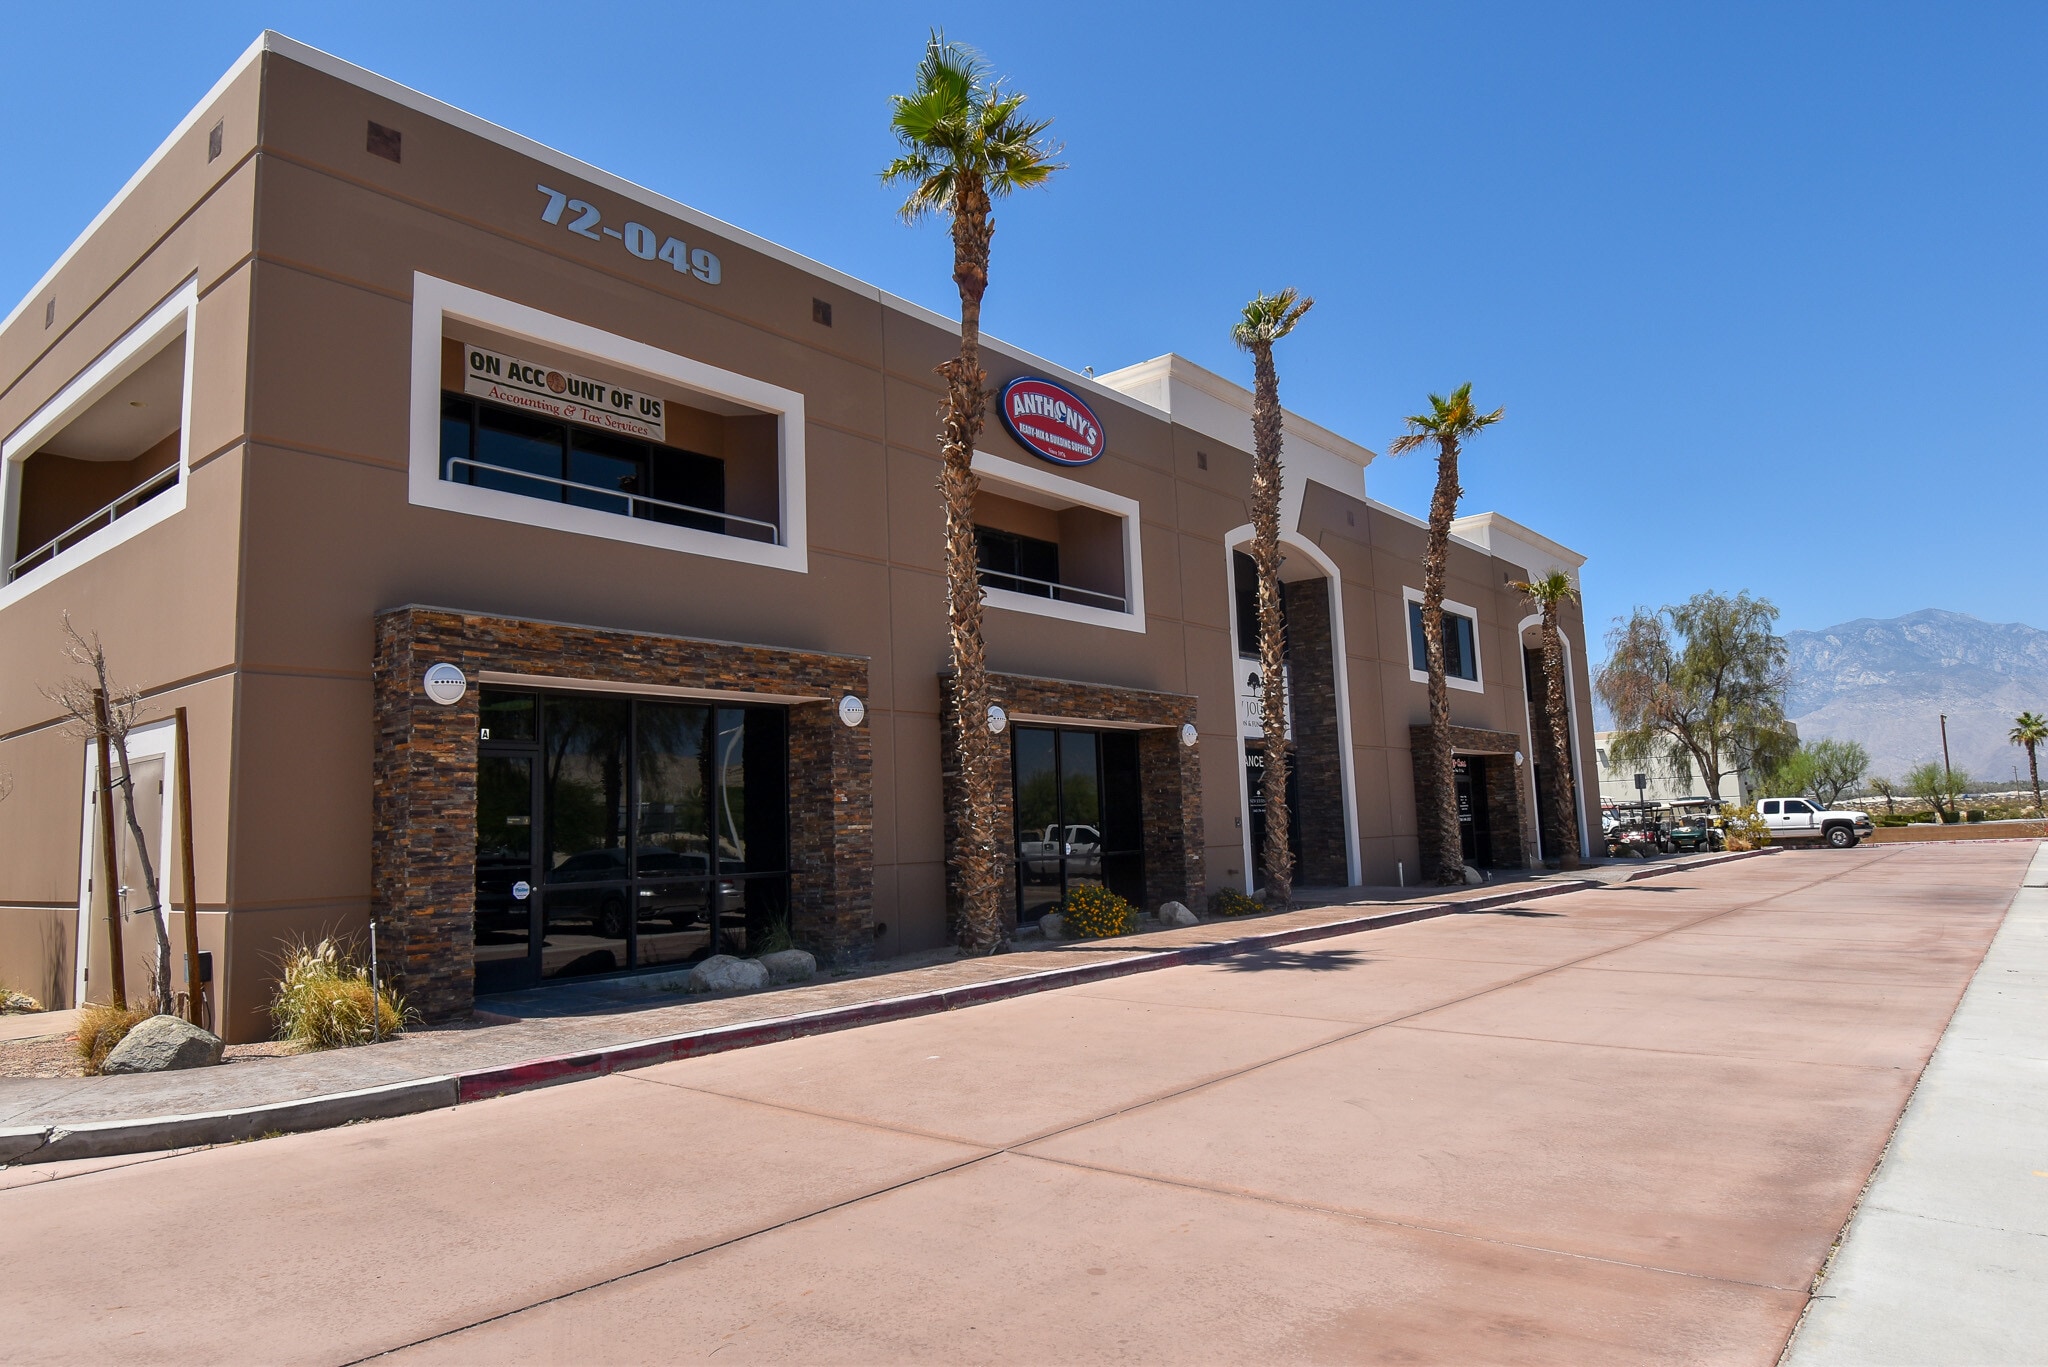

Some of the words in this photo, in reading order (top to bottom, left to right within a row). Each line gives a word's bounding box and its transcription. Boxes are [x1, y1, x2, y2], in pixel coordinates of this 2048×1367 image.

[537, 183, 722, 285] 72-049
[470, 351, 501, 376] ON
[508, 361, 605, 403] ACCOUNT
[610, 390, 633, 410] OF
[639, 397, 661, 418] US
[488, 385, 560, 416] Accounting
[563, 405, 576, 417] &
[581, 408, 602, 424] Tax
[604, 415, 648, 436] Services
[1013, 392, 1098, 446] ANTHONY'S
[1019, 422, 1045, 440] READY-MIX
[1050, 434, 1071, 449] BUILDING
[1071, 442, 1093, 456] SUPPLIES
[483, 730, 488, 738] A
[1244, 755, 1264, 768] ANCE
